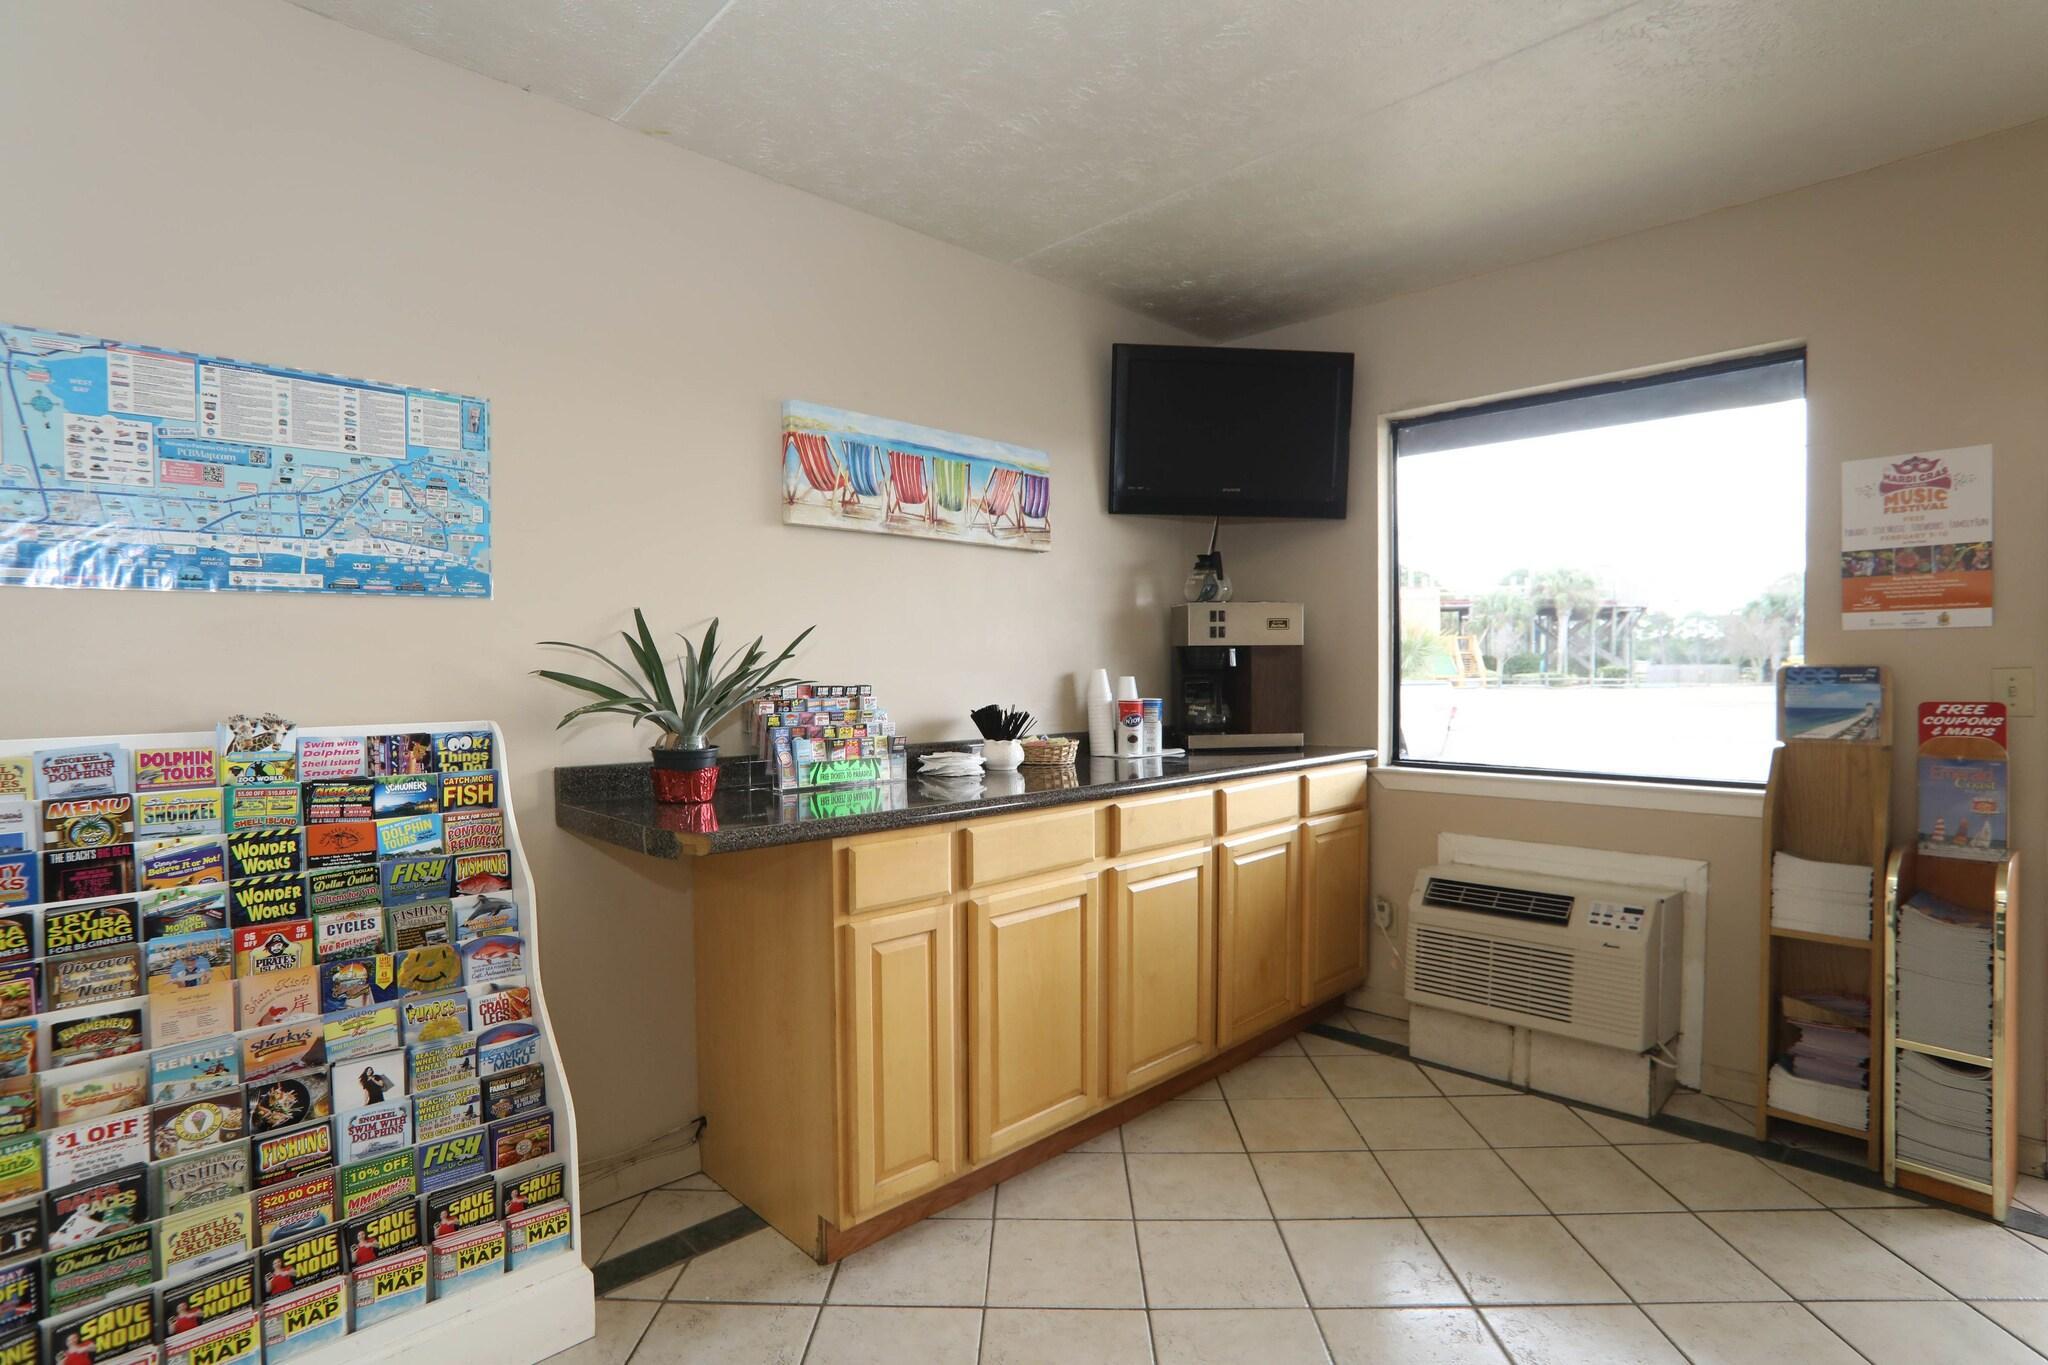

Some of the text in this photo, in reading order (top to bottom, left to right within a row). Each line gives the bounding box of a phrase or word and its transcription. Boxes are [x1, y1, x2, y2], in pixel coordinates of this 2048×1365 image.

[1883, 473, 1917, 482] MARDI
[1883, 488, 1949, 507] MUSIC
[1883, 502, 1949, 514] FESTIVAL
[1787, 668, 1838, 684] see
[1936, 704, 1989, 715] FREE
[1922, 716, 2004, 727] COUPONS
[1931, 727, 1996, 737] & MAPS
[303, 748, 360, 758] Dolphins
[304, 741, 334, 749] Swim
[438, 735, 489, 751] LOOK!
[54, 755, 103, 765] SNORKEL
[140, 751, 214, 768] DOLPHIN
[302, 758, 361, 768] Shell Island
[438, 750, 489, 764] Things
[439, 761, 487, 772] To Do!
[42, 760, 116, 776] SWIM WITH
[48, 768, 113, 783] DOLPHINS
[161, 766, 215, 780] TOURS
[304, 767, 359, 777] Snorkel
[238, 774, 285, 783] ZOO WORLD
[385, 781, 428, 794] SCHOONERS
[443, 774, 494, 785] CATCH MORE
[443, 783, 494, 808] FISH
[46, 797, 131, 819] MENU
[143, 802, 217, 824] SNORKEL
[234, 817, 297, 828] SHELL ISLAND
[382, 820, 433, 840] DOLPHIN
[448, 824, 500, 841] PONTOON
[232, 840, 297, 861] WONDER
[384, 834, 417, 850] TOURS
[450, 836, 501, 852] RENTALS
[50, 849, 97, 864] THE BEACH'S
[148, 864, 180, 877] Believe
[182, 860, 191, 869] It
[203, 854, 221, 865] Not!
[242, 856, 291, 875] WORKS
[355, 867, 374, 875] DOLLAR
[390, 860, 446, 884] FISH
[457, 854, 507, 881] FISHING
[313, 872, 375, 892] Dollar Outlet
[236, 885, 302, 908] WONDER
[47, 910, 97, 926] TRY
[246, 902, 297, 922] WORKS
[392, 904, 448, 922] FISHING
[47, 924, 133, 948] DIVING
[48, 914, 131, 938] SCUBA
[326, 918, 376, 936] CYCLES
[49, 934, 134, 955] FOR BEGINNERS
[319, 941, 352, 954] We Rent
[60, 954, 134, 975] Discover
[255, 954, 297, 968] PIRATE'S
[259, 964, 293, 973] ISLAND
[79, 981, 124, 998] Now!
[479, 998, 510, 1016] CRAB
[483, 1009, 511, 1026] LEGS
[58, 1018, 134, 1041] HAMMERHEAD
[155, 1046, 236, 1073] RENTALS
[416, 1049, 441, 1060] BEACH
[488, 1042, 537, 1063] SAMPLE
[494, 1055, 530, 1072] MENU
[489, 1083, 510, 1093] FAMILY
[348, 1114, 408, 1136] SWIM WITH
[358, 1111, 398, 1125] SNORKEL
[57, 1118, 138, 1148] $1 OFF
[352, 1125, 404, 1143] DOLPHINS
[260, 1127, 329, 1171] FISHING
[422, 1134, 483, 1169] FISH
[167, 1159, 246, 1190] FISHING
[350, 1156, 410, 1183] 10% OFF
[519, 1171, 561, 1195] SAVE
[263, 1180, 329, 1209] $20.00 OFF
[449, 1187, 494, 1218] SAVE
[528, 1184, 560, 1204] NOW
[367, 1207, 416, 1238] SAVE
[459, 1204, 495, 1227] NOW
[527, 1213, 568, 1231] VISITOR'S
[176, 1222, 237, 1249] ISLAND
[181, 1214, 229, 1238] SHELL
[529, 1220, 568, 1242] MAP
[172, 1227, 241, 1258] CRUISES
[377, 1223, 417, 1250] NOW
[442, 1243, 468, 1254] PANAMA
[468, 1239, 482, 1248] CITY
[283, 1235, 338, 1266] SAVE
[459, 1239, 502, 1256] VISITOR'S
[461, 1246, 502, 1269] MAP
[55, 1240, 148, 1277] Dollar Outlet
[295, 1250, 338, 1278] NOW
[358, 1256, 424, 1279] PANAMA CITY BEACH
[377, 1264, 424, 1281] VISITOR'S
[189, 1274, 250, 1308] SAVE
[378, 1271, 424, 1295] MAP
[203, 1289, 251, 1318] NOW
[287, 1293, 339, 1318] VISITOR'S
[297, 1297, 314, 1307] CITY
[80, 1300, 150, 1341] SAVE
[288, 1301, 339, 1333] MAP
[95, 1320, 151, 1354] NOW
[192, 1329, 252, 1355] VISITOR'S
[194, 1337, 250, 1365] MAP
